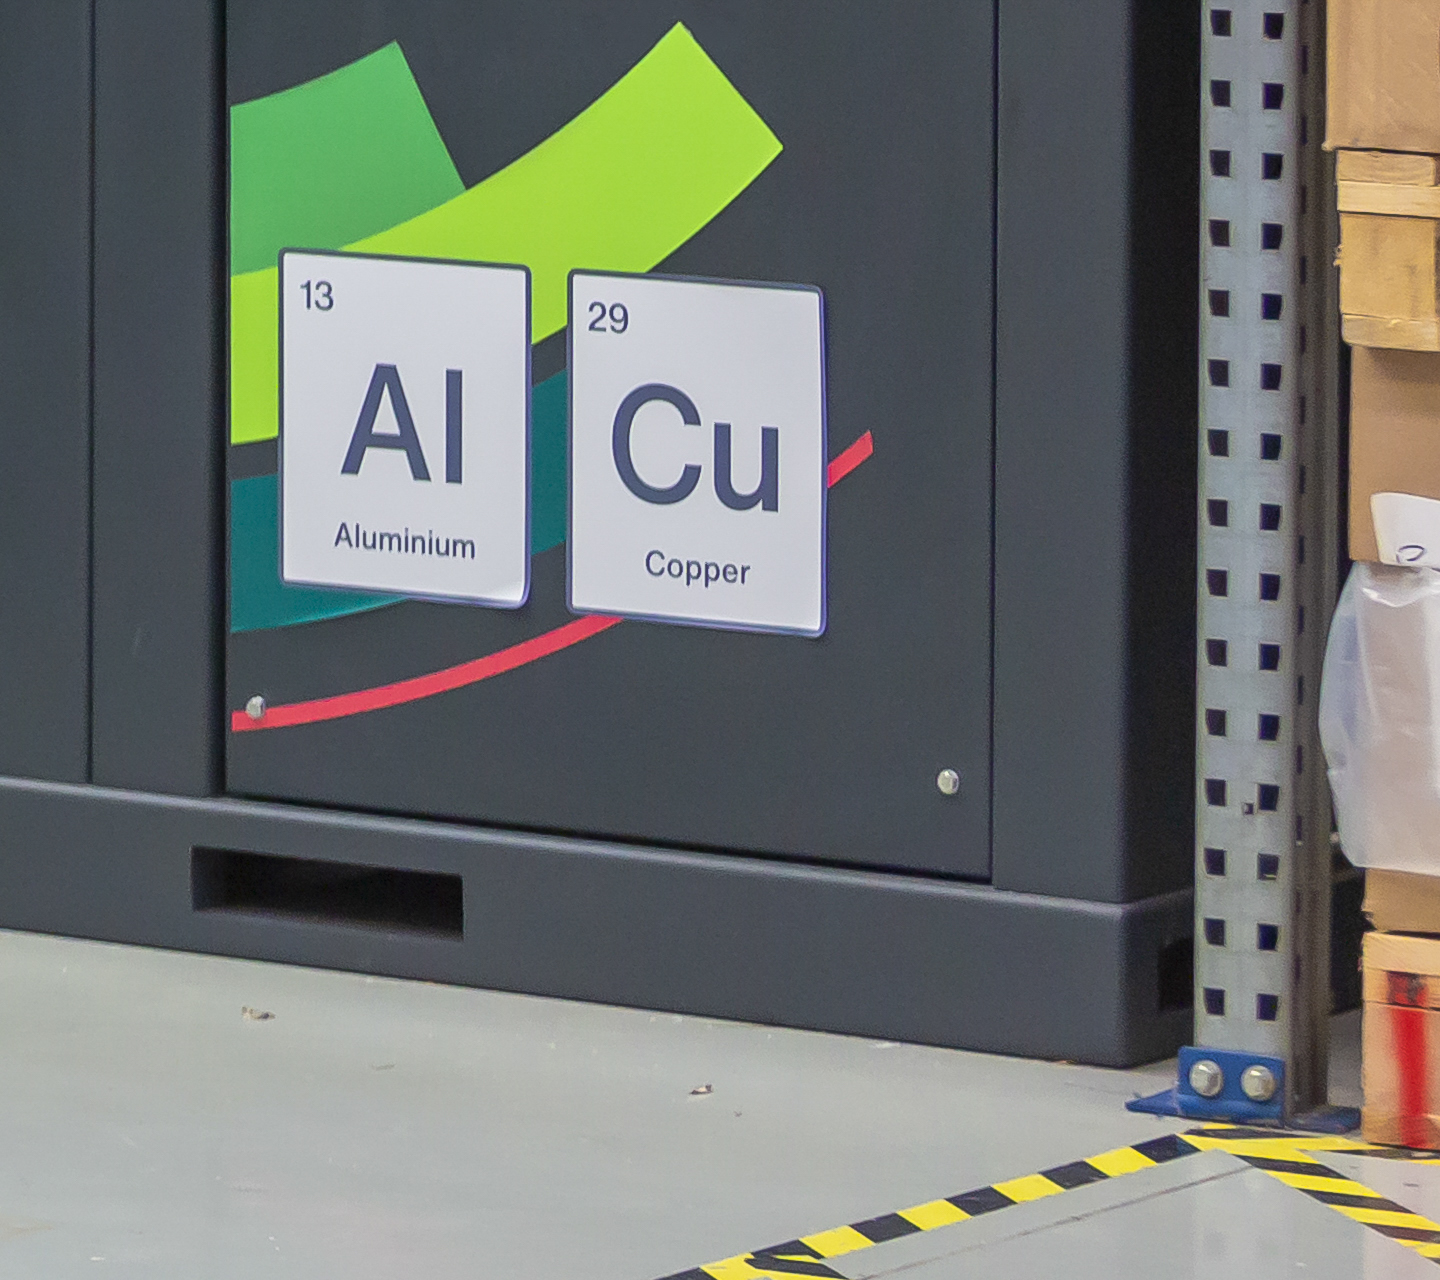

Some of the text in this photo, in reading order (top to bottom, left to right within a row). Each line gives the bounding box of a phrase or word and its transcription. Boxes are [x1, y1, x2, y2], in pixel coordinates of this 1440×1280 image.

[300, 280, 335, 312] 13
[588, 302, 630, 335] 29
[340, 362, 464, 485] Al
[611, 382, 780, 513] Cu
[334, 521, 476, 561] Aluminium
[645, 549, 752, 588] Copper
